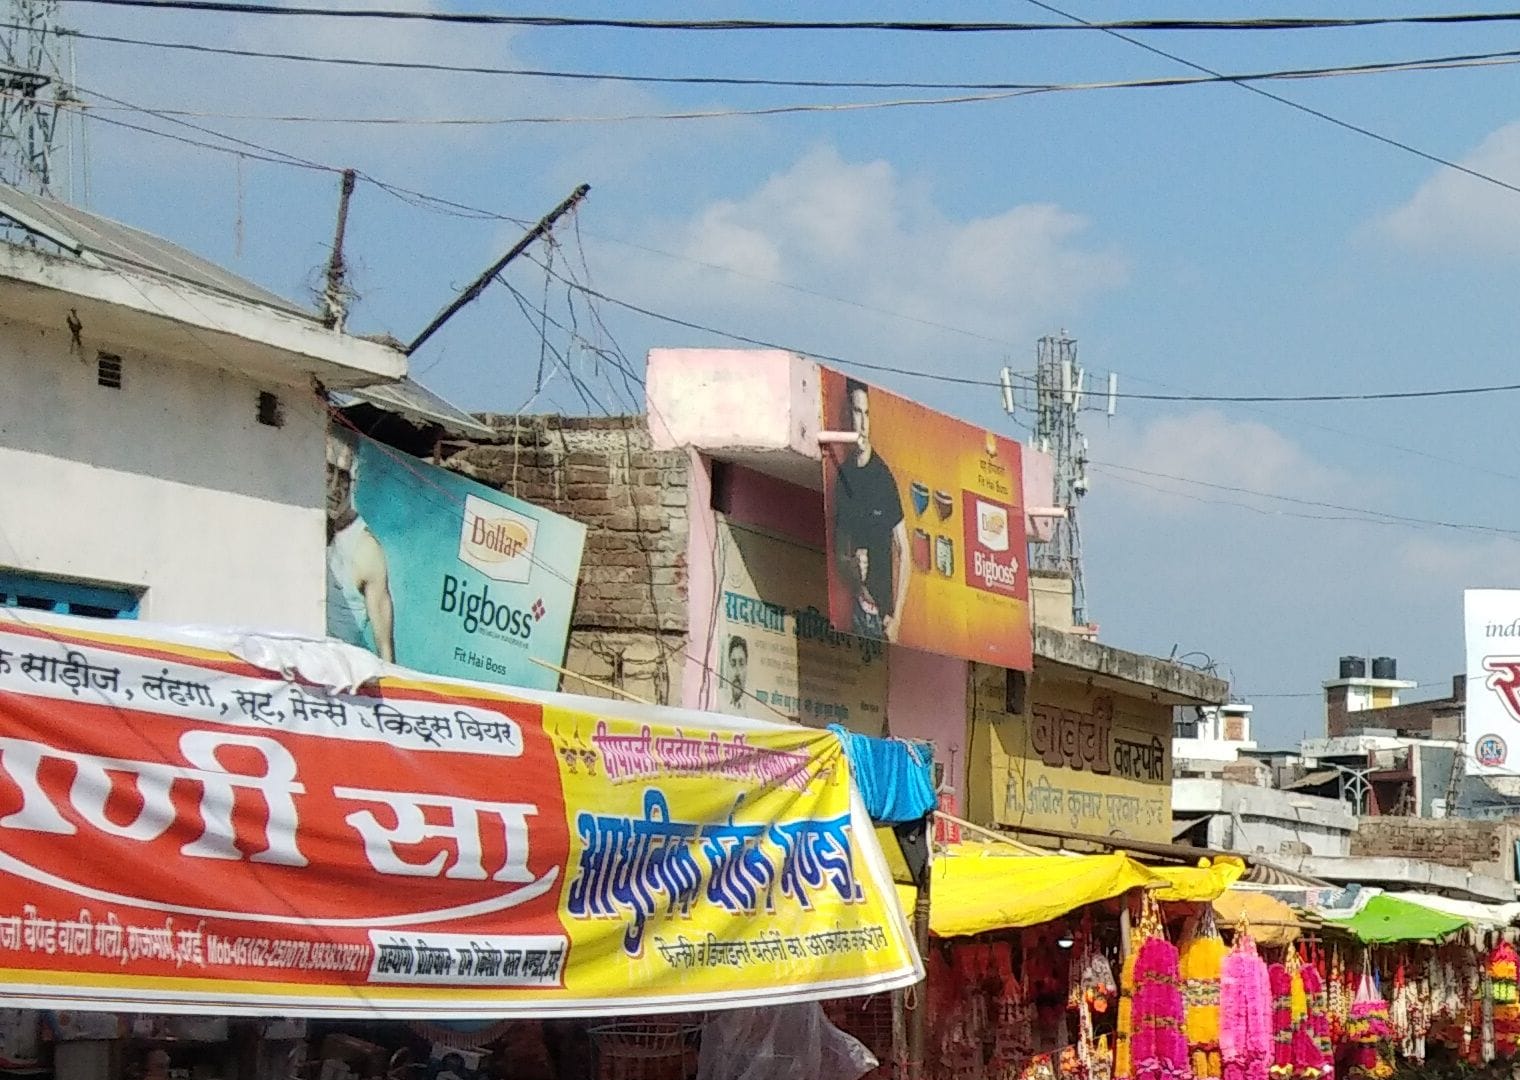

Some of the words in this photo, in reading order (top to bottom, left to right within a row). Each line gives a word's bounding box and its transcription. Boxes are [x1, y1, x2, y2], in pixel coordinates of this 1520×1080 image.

[471, 516, 526, 558] Dollar
[974, 551, 1015, 588] Bigboss
[440, 574, 533, 640] Bigboss
[453, 646, 466, 662] Fit
[467, 650, 484, 669] Hai
[485, 657, 507, 676] Boss
[455, 710, 515, 747] वियर
[334, 786, 538, 883] सा
